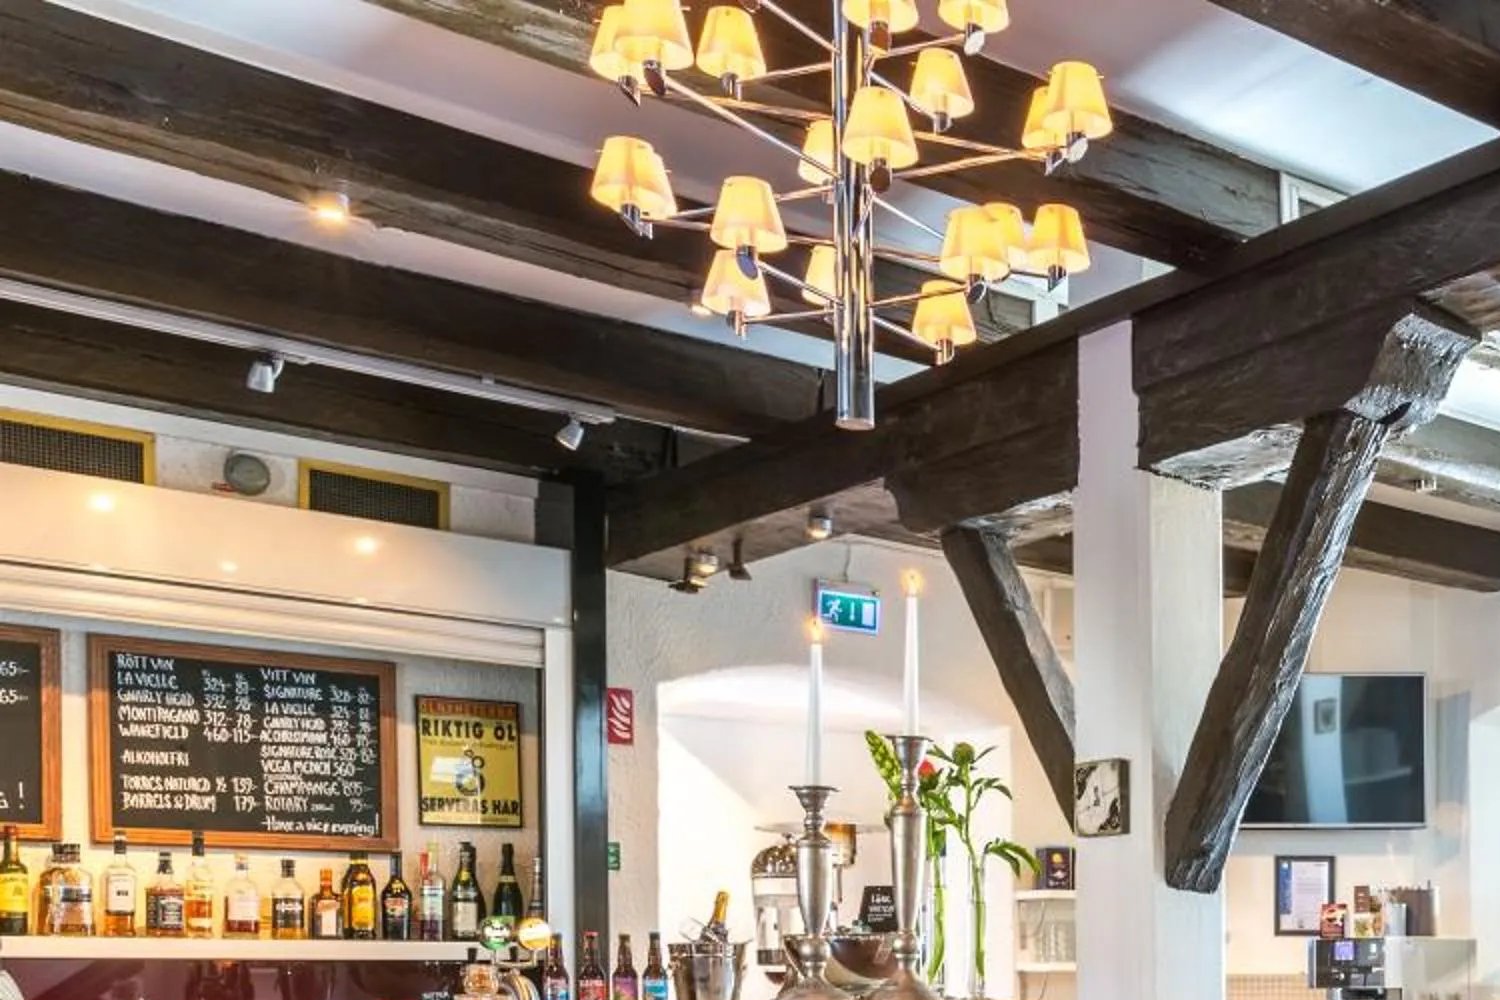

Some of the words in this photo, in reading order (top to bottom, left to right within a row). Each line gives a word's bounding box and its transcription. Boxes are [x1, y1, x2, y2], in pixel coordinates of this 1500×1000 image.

[116, 653, 148, 669] RÖTT
[151, 658, 175, 671] VIN
[117, 671, 133, 685] LA
[260, 668, 291, 682] VITT
[292, 671, 316, 685] VIN
[265, 702, 279, 715] LA
[421, 718, 485, 739] RIKTIG
[494, 721, 517, 742] ÖL
[121, 750, 189, 766] ALKOHOLFRI
[261, 815, 294, 832] Have
[295, 821, 305, 831] a
